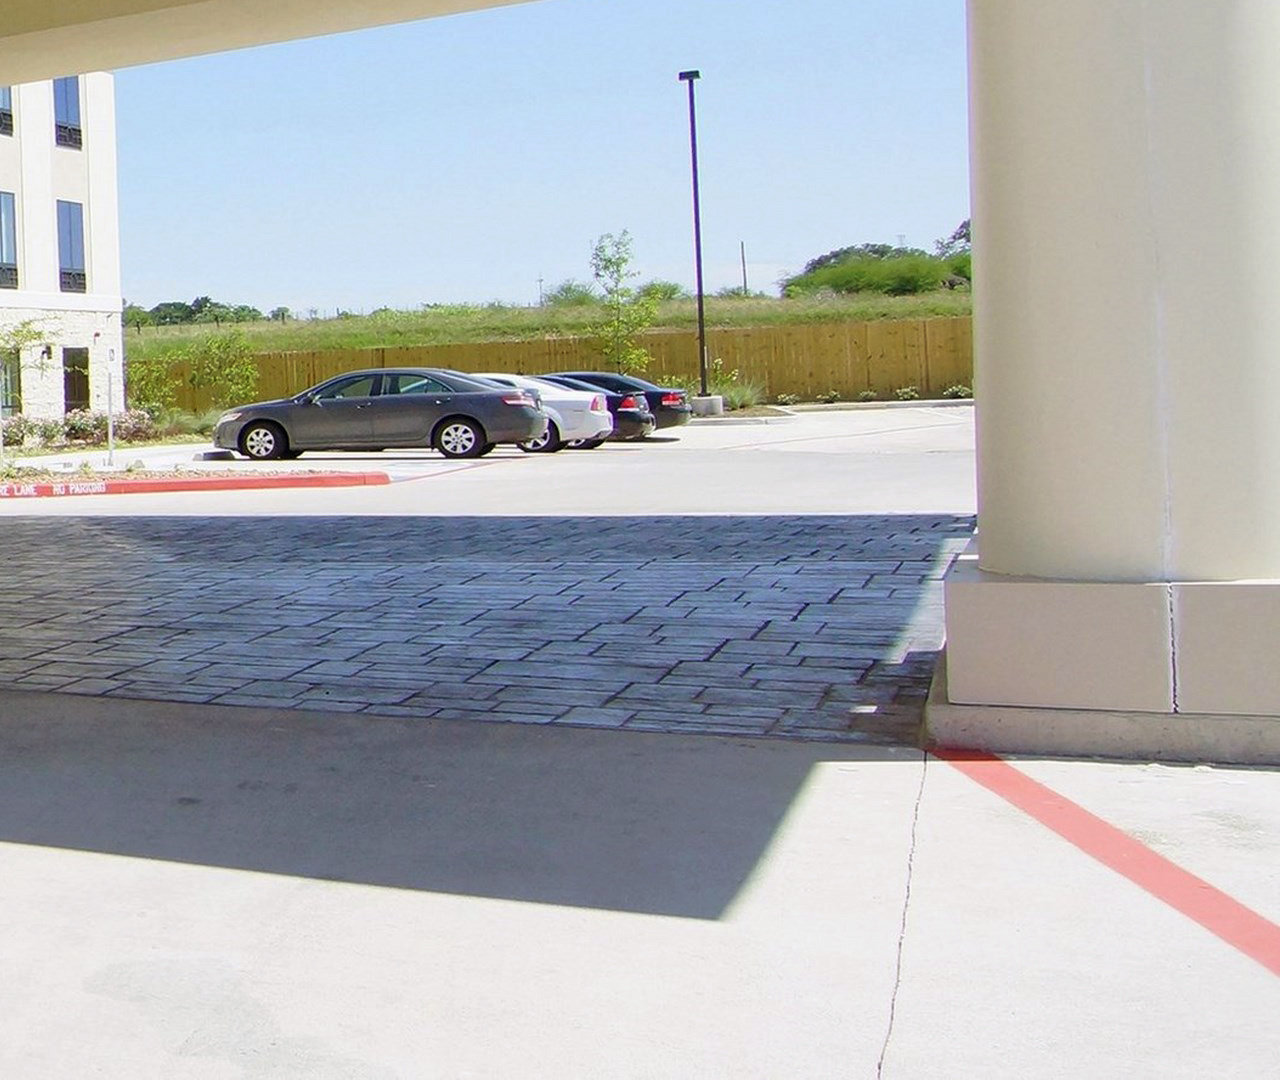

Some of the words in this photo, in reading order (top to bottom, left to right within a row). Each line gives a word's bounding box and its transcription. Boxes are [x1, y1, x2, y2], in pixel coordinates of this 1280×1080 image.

[13, 482, 38, 496] LANE
[52, 482, 66, 495] NO
[69, 480, 107, 494] PARKING
